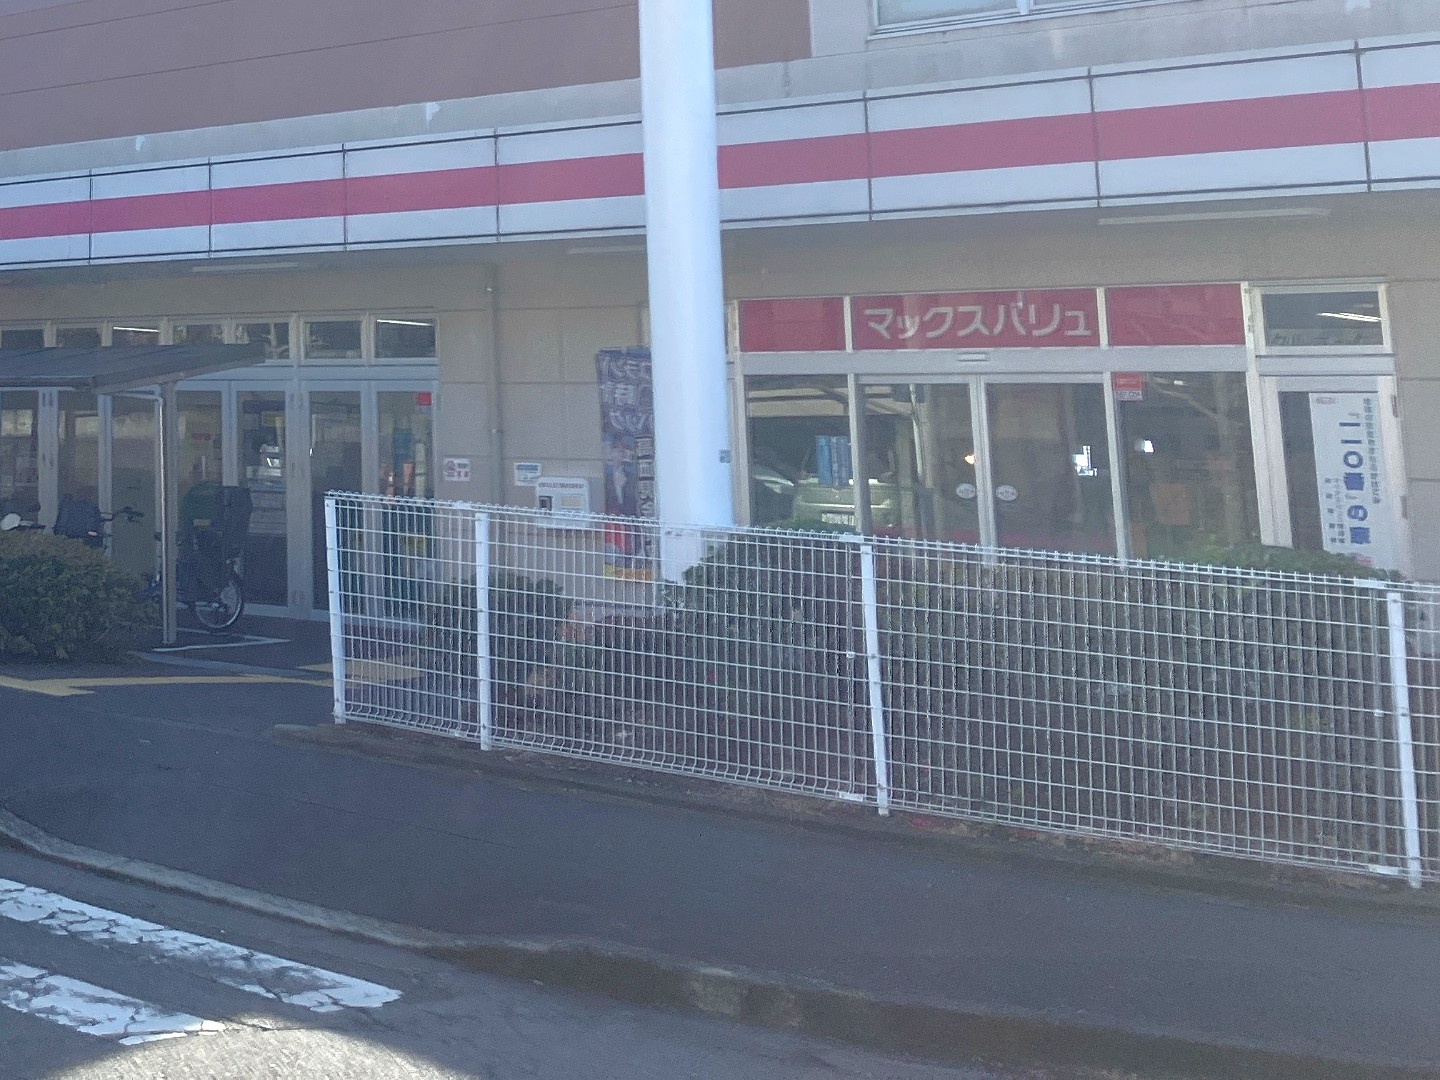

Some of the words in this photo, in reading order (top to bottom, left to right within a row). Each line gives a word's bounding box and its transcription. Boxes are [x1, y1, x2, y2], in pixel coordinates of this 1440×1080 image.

[863, 301, 1092, 340] マックスバリュ
